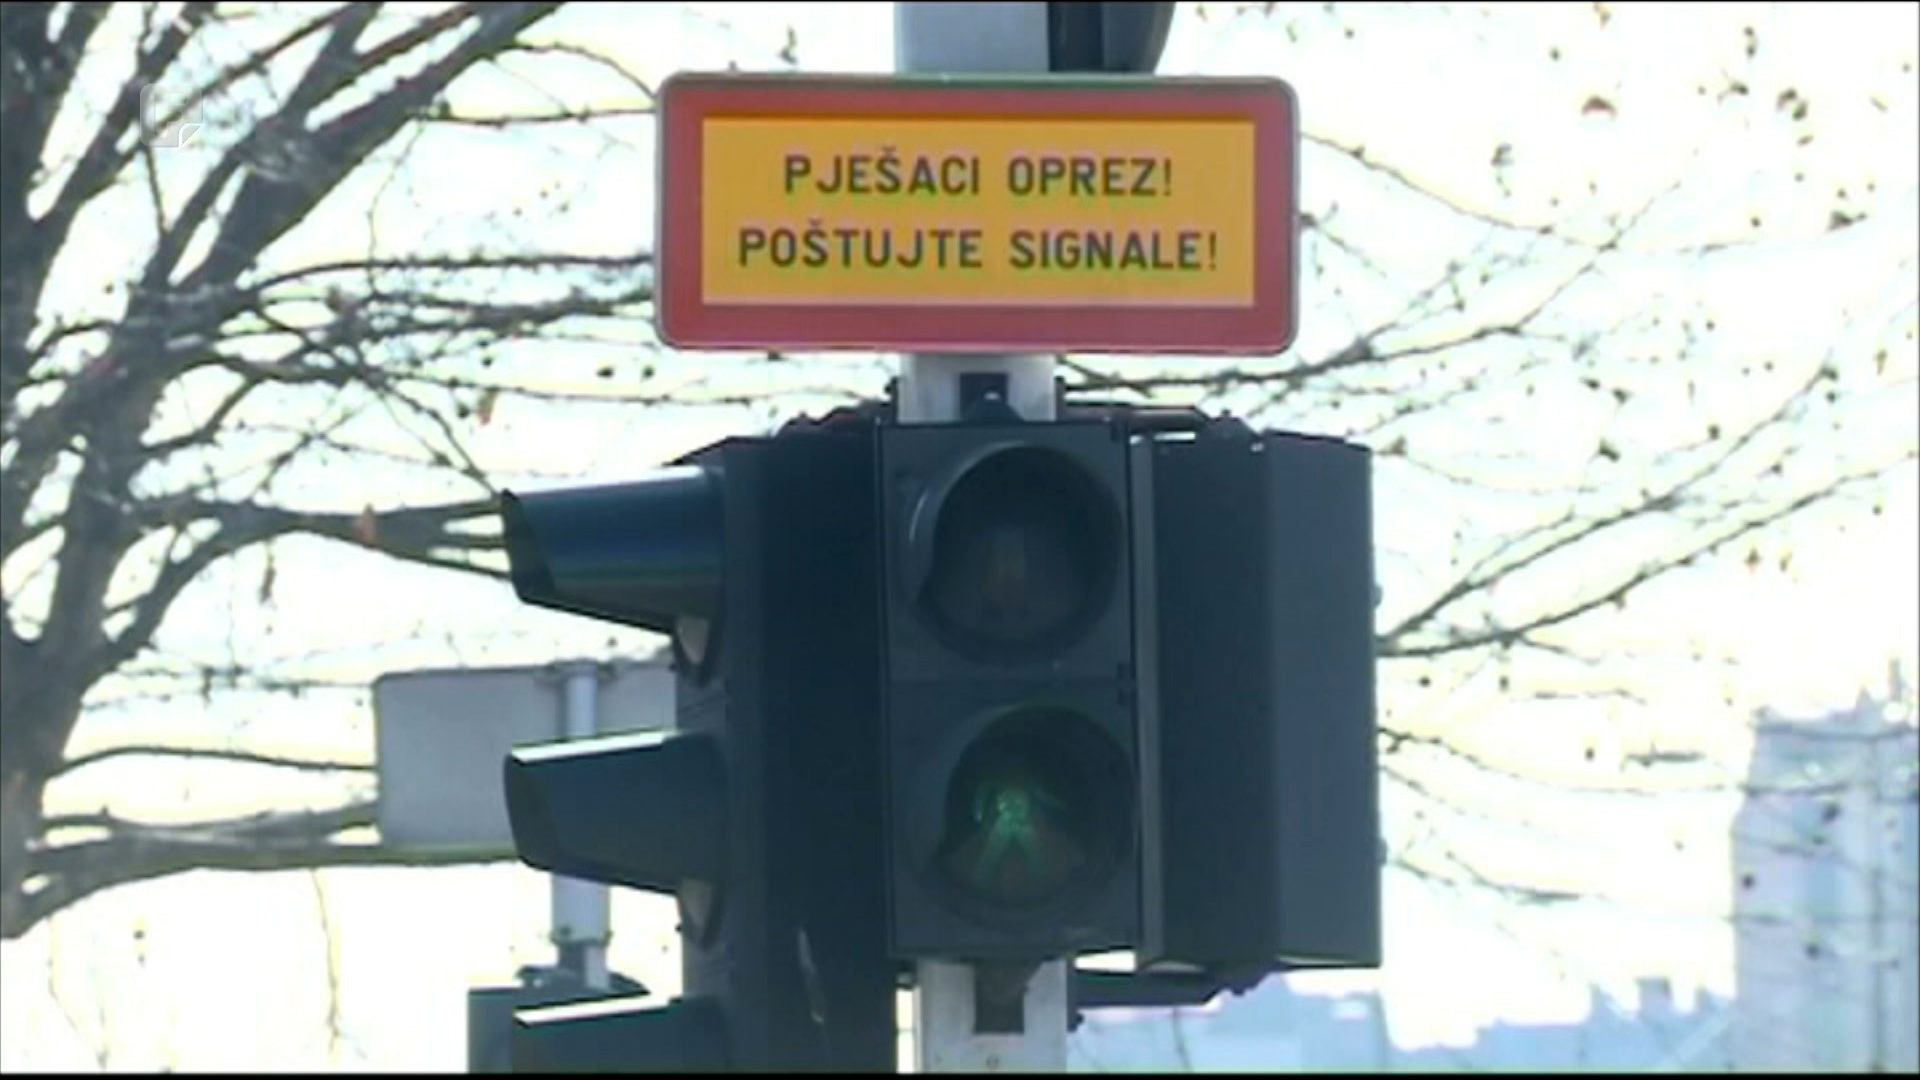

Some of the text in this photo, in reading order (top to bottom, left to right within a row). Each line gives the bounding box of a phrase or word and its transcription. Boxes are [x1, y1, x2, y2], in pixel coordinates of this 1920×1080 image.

[784, 146, 1173, 197] PJEŠACI OPREZ!
[738, 219, 1218, 271] POŠTUJTE SIGNALE!
